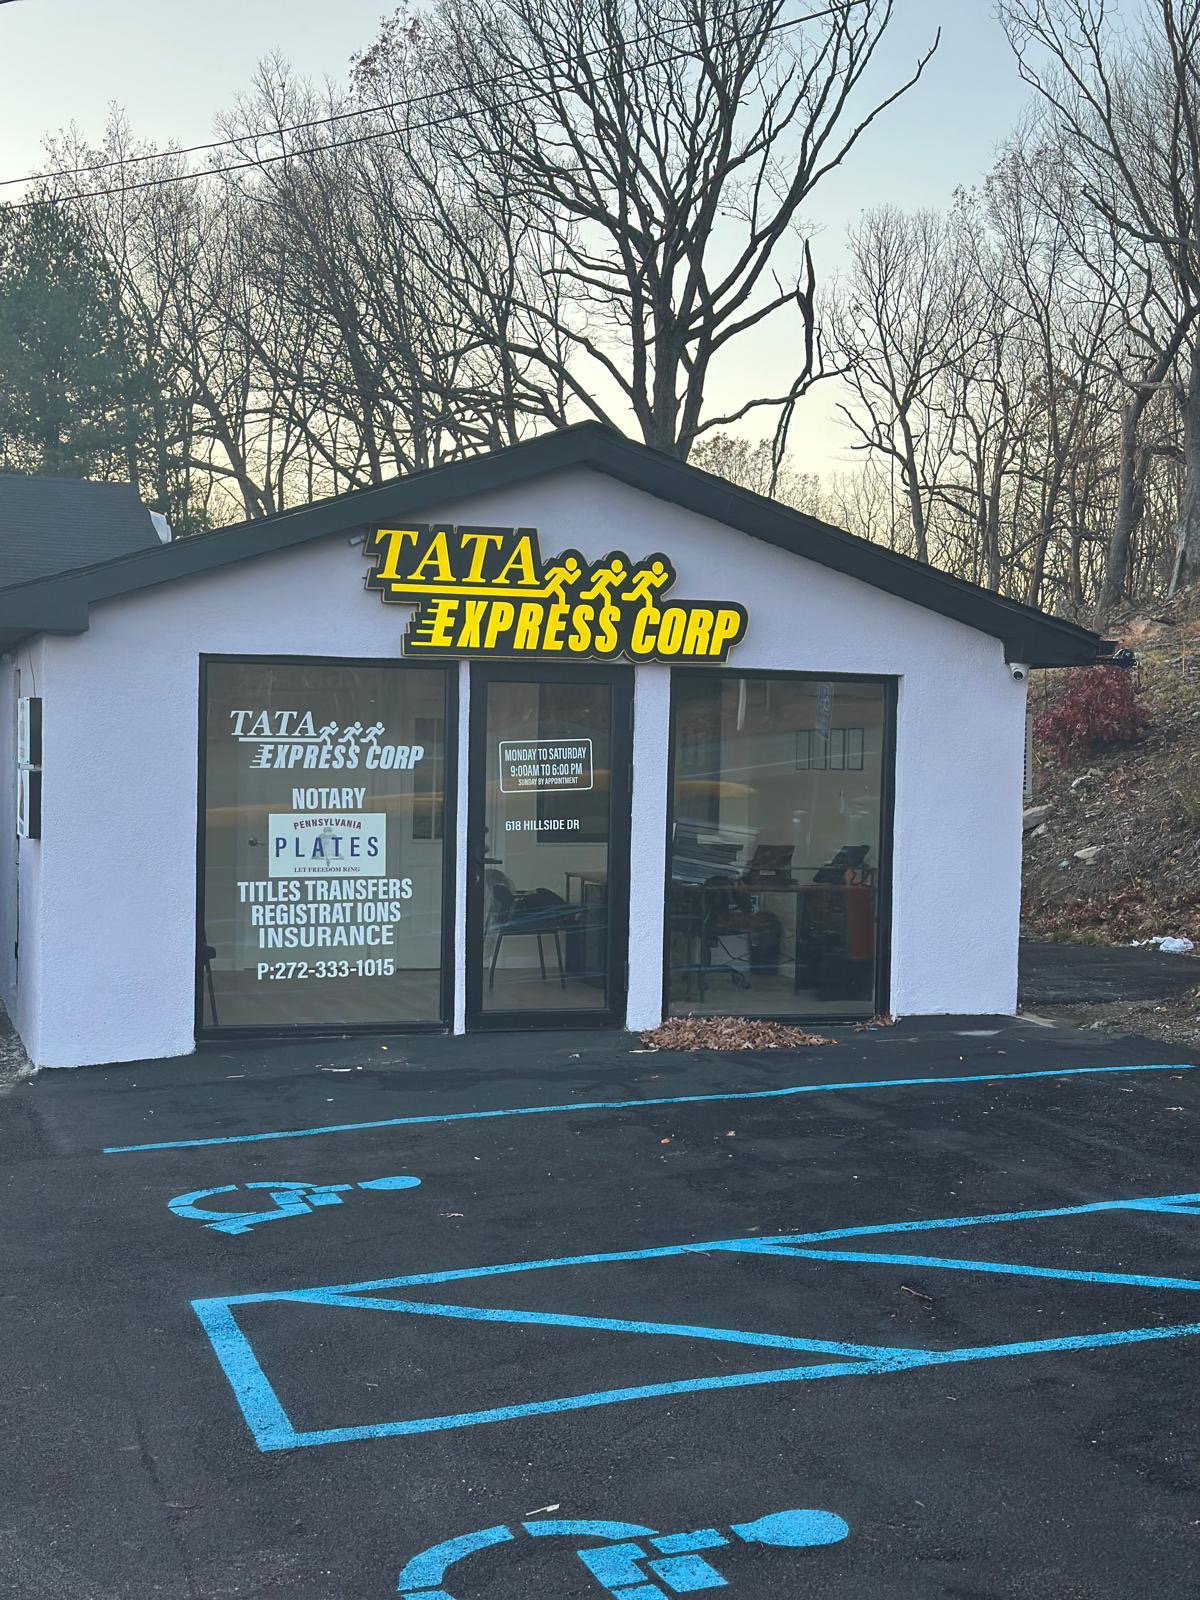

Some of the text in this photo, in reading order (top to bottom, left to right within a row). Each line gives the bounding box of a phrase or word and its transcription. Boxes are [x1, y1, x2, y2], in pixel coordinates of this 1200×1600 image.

[375, 529, 540, 585] TATA
[411, 599, 742, 656] EXPRESS CORP
[230, 710, 318, 737] TATA
[249, 744, 425, 770] EXPRESS CORP
[504, 746, 587, 762] MONDAY TO SATURDAY
[510, 762, 583, 777] 9:00AM TO 6:00 PM
[518, 776, 578, 786] SUNDAY BY APPOINTMENT
[292, 787, 366, 810] NOTARY
[293, 817, 363, 831] PENNSYLVANIA
[505, 819, 580, 831] 618 HILLSIDE DR
[275, 836, 379, 858] PLATES
[237, 878, 413, 903] TITLES TRANSFERS
[251, 901, 402, 926] REGISTRATIONS
[259, 925, 394, 949] INSURANCE
[257, 958, 395, 981] P:272-333-1015
